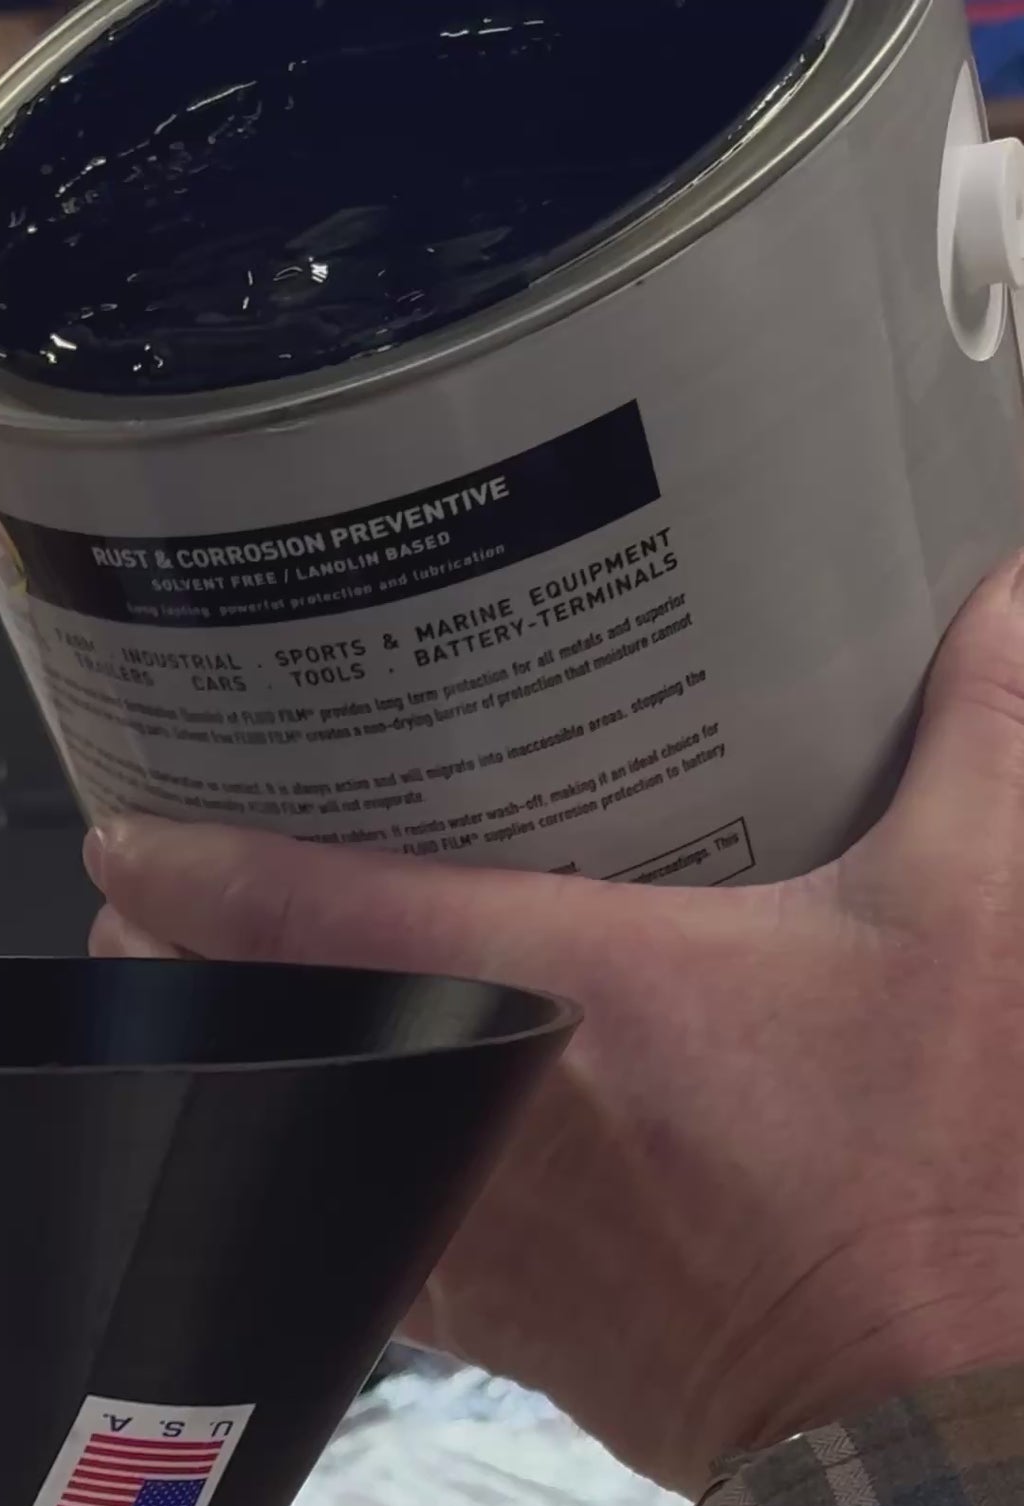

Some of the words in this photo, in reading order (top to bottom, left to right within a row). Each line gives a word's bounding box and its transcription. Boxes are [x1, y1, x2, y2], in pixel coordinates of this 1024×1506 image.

[91, 546, 149, 569] RUST
[155, 550, 174, 569] &
[177, 533, 326, 569] CORROSION
[331, 476, 510, 549] PREVENTIVE
[151, 576, 225, 592] SOLVENT
[231, 571, 277, 589] FREE
[296, 552, 380, 580] LANOLIN
[385, 531, 451, 561] BASED
[121, 647, 243, 671] INDUSTRIAL
[275, 638, 367, 667] SPORTS
[382, 632, 400, 650] &
[414, 597, 514, 643] MARINE
[529, 526, 672, 607] EQUIPMENT
[191, 674, 247, 692] CARS
[289, 662, 366, 688] TOOLS
[413, 551, 678, 667] BATTERY-TERMINALS
[291, 584, 373, 611] protection
[379, 574, 409, 591] and
[413, 543, 505, 582] lubrication
[320, 702, 373, 723] provides
[374, 697, 405, 712] long
[407, 689, 439, 705] term
[443, 667, 510, 699] protection
[511, 660, 532, 676] for
[537, 649, 555, 669] all
[558, 631, 604, 660] metals
[606, 617, 632, 640] and
[634, 592, 687, 627] superior
[363, 713, 434, 732] non-drying
[433, 700, 478, 722] barrier
[482, 693, 495, 709] of
[497, 673, 563, 707] protection
[564, 659, 593, 681] that
[593, 635, 649, 670] moisture
[651, 611, 693, 645] cannot
[477, 751, 504, 768] into
[507, 724, 585, 759] inaccessible
[630, 680, 684, 714] stopping
[684, 669, 707, 688] the
[447, 811, 483, 829] water
[549, 777, 597, 804] making
[597, 770, 609, 787] it
[610, 765, 627, 782] an
[628, 749, 660, 775] ideal
[661, 731, 701, 759] choice
[701, 721, 720, 739] for
[482, 818, 536, 844] supplies
[538, 799, 598, 829] corrosion
[601, 771, 665, 811] protection
[665, 764, 681, 781] to
[681, 742, 727, 773] battery
